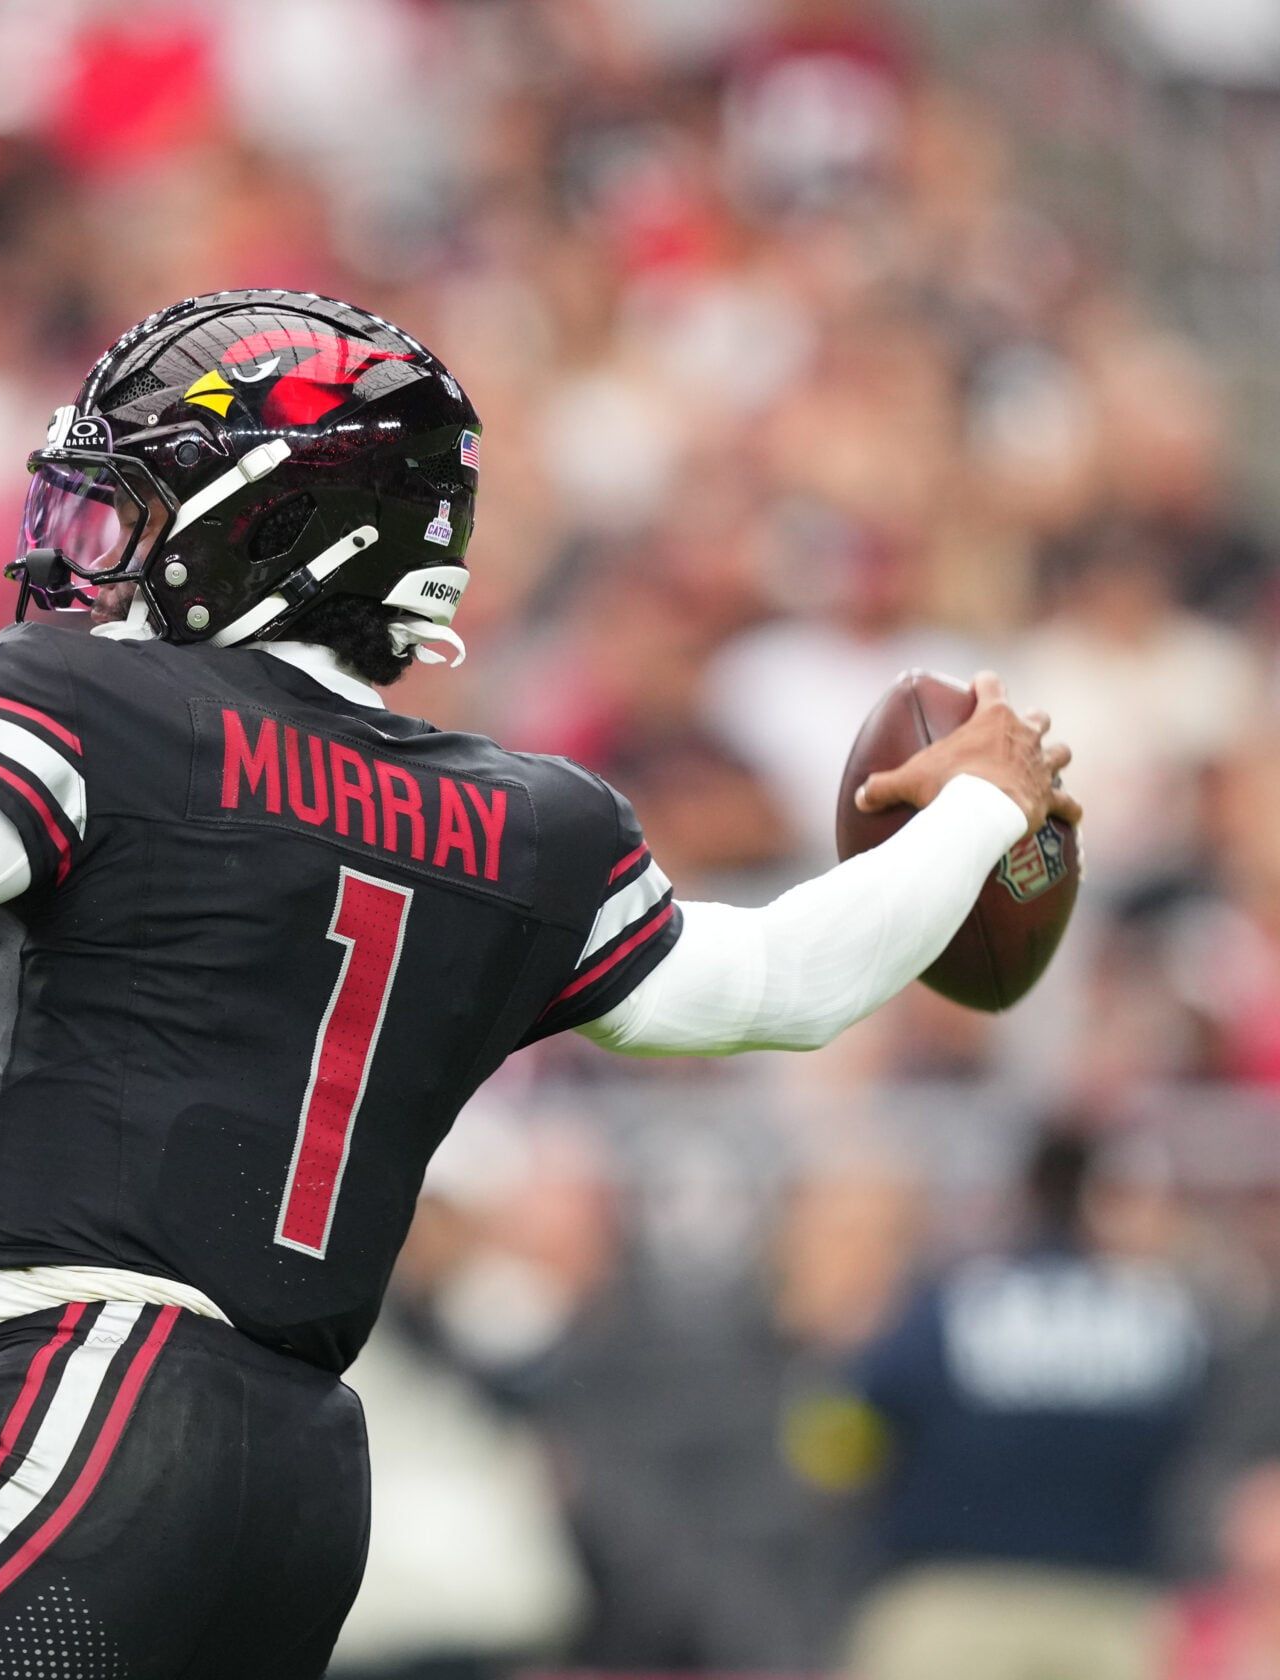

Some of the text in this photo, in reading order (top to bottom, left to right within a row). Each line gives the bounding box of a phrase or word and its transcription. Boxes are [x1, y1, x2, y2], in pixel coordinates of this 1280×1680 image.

[65, 437, 105, 446] OAKLEY
[427, 524, 451, 539] CATCH
[221, 709, 507, 882] MURRAY
[1009, 833, 1045, 892] NFL
[273, 865, 415, 1261] 1
